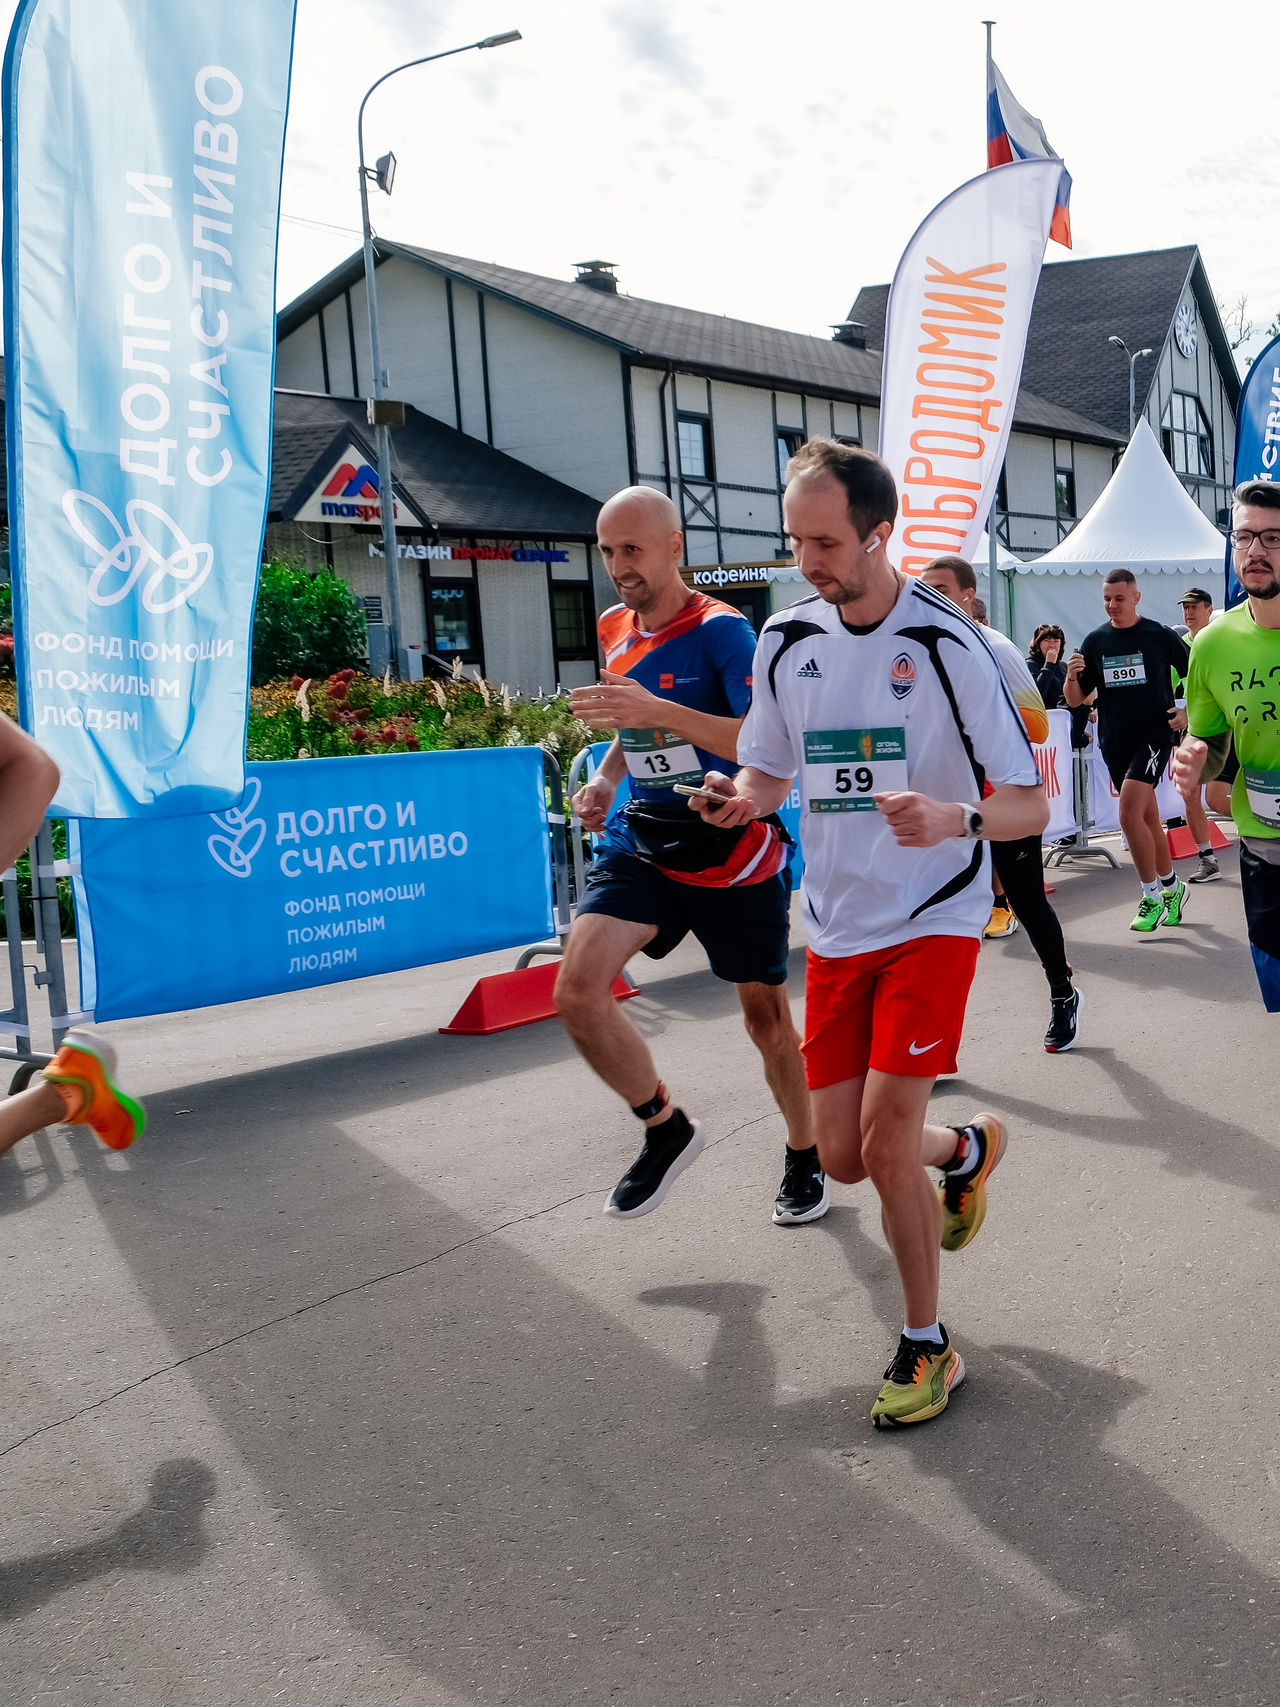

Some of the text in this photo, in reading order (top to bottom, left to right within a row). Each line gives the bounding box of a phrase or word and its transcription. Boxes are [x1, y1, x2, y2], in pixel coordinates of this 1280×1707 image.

[186, 64, 244, 487] СЧАСТЛИВО
[119, 171, 176, 487] ДОЛГО И
[321, 501, 398, 522] marspt
[368, 542, 451, 561] МГАЗИН
[452, 546, 512, 561] ПРОКАТ
[512, 550, 569, 563] СЕРВИС
[693, 565, 768, 587] кофейня
[34, 631, 235, 663] ФОНД ПОМОЩИ
[36, 669, 180, 699] ПОЖИЛЫМ
[797, 670, 823, 679] adidas
[1112, 668, 1136, 680] 890
[39, 705, 139, 732] ЛЮДЯМ
[644, 754, 671, 774] 13
[835, 766, 874, 794] 59
[275, 800, 416, 846] ДОЛГО И
[279, 830, 468, 878] СЧАСТЛИВО
[284, 882, 426, 917] ФОНД ПОМОЩИ
[287, 915, 386, 946] ПОЖИЛЫМ
[288, 947, 358, 974] ЛЮДЯМ
